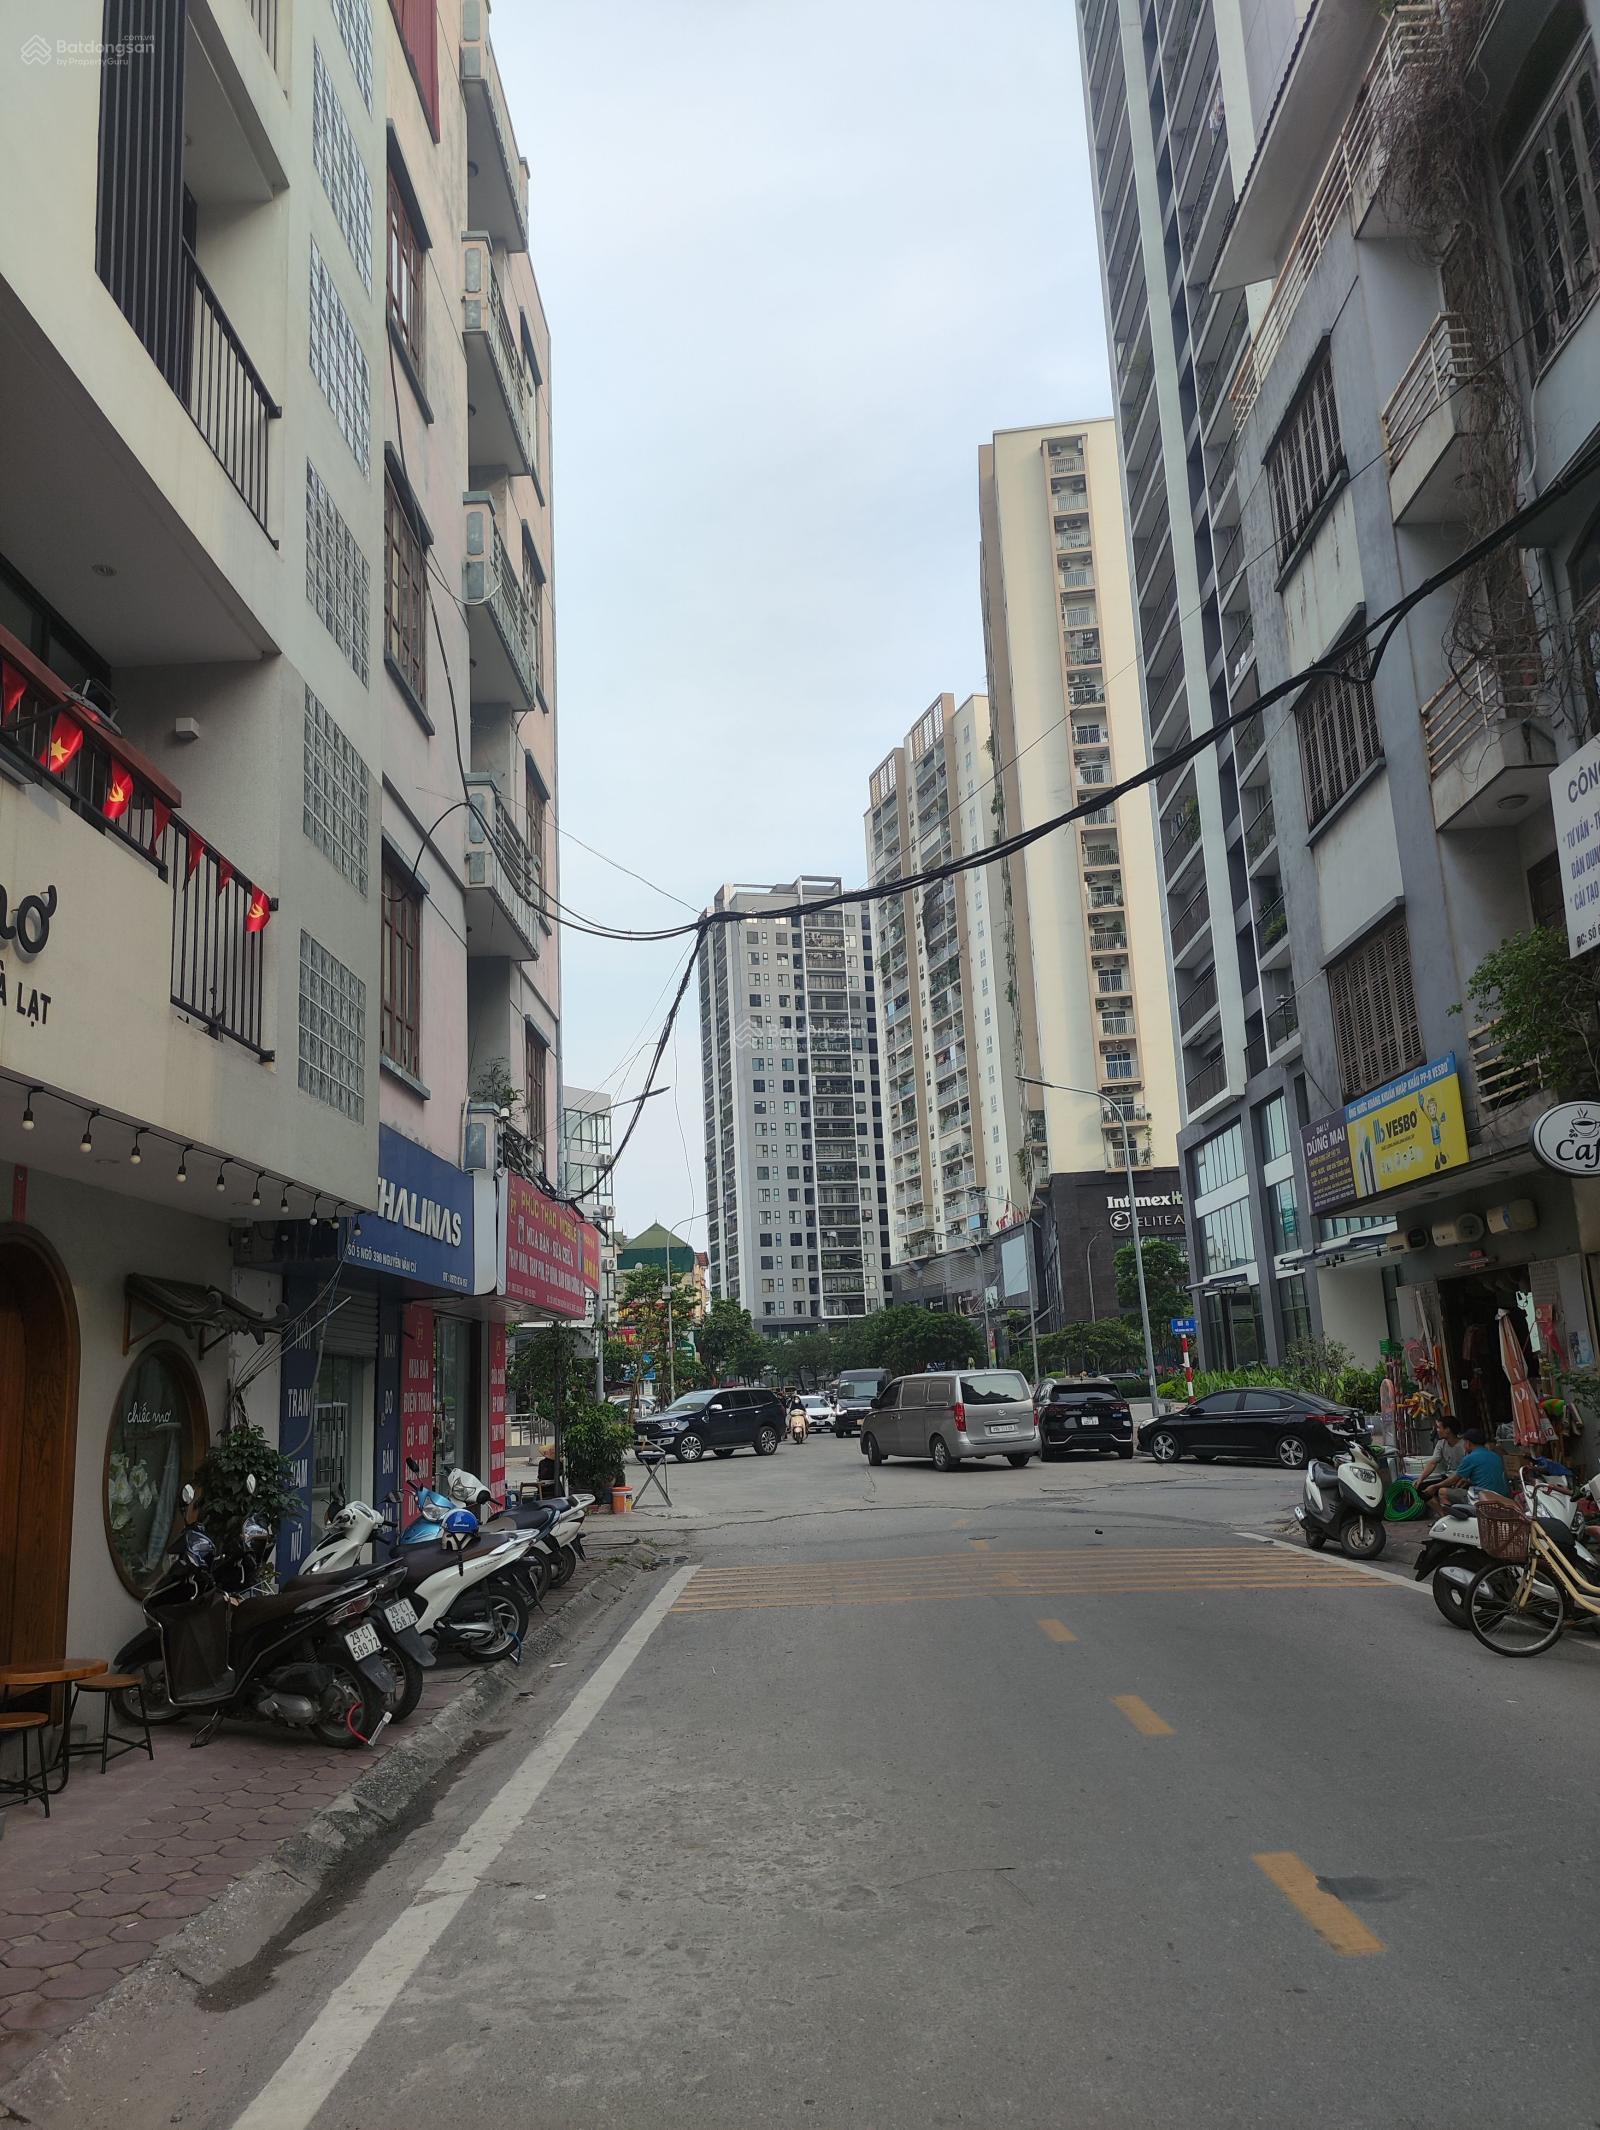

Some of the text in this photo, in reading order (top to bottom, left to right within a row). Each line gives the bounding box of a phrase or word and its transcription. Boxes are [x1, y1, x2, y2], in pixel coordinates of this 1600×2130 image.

[16, 982, 51, 1027] LẠT
[1432, 1062, 1448, 1079] VESBO
[1386, 1110, 1418, 1138] VESBO
[1329, 1126, 1346, 1146] MAI
[378, 1177, 462, 1247] HALINAS
[1106, 1194, 1171, 1209] Intmex
[127, 1401, 172, 1423] chiếc mơ
[349, 1625, 373, 1646] 29-C1
[352, 1636, 380, 1659] 589.72
